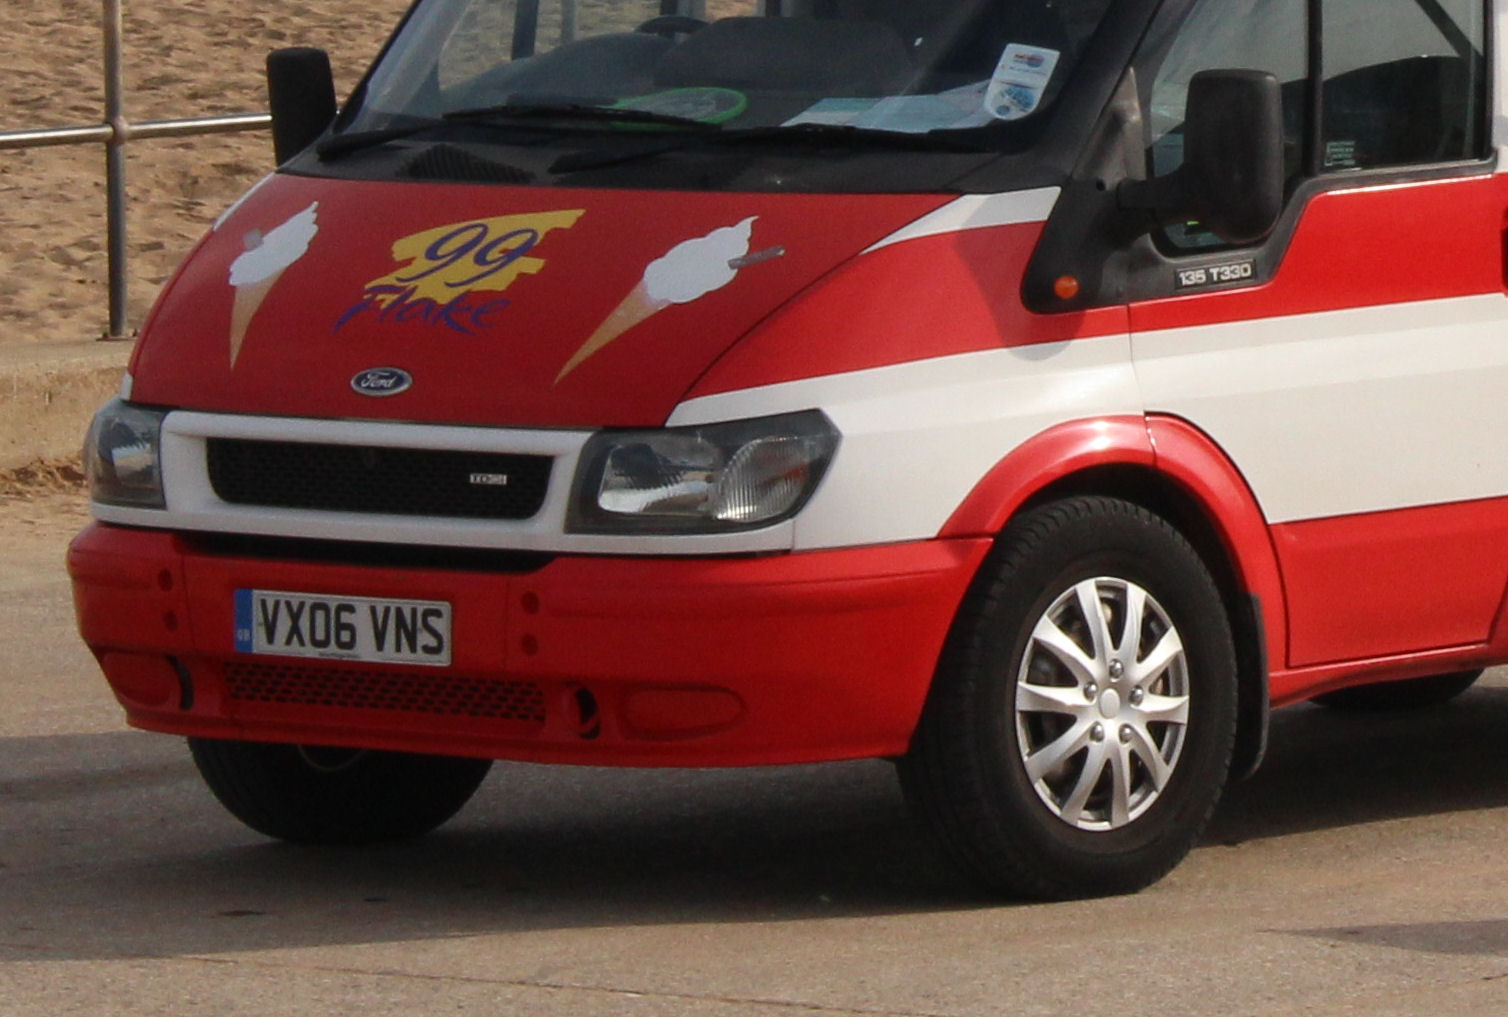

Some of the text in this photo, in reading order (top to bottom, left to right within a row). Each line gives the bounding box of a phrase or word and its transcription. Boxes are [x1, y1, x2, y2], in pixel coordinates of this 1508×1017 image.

[394, 222, 540, 289] 99
[1179, 263, 1252, 286] 135 T330
[330, 282, 512, 336] Flake
[360, 370, 396, 389] Ford
[259, 598, 444, 656] VX06 VNS
